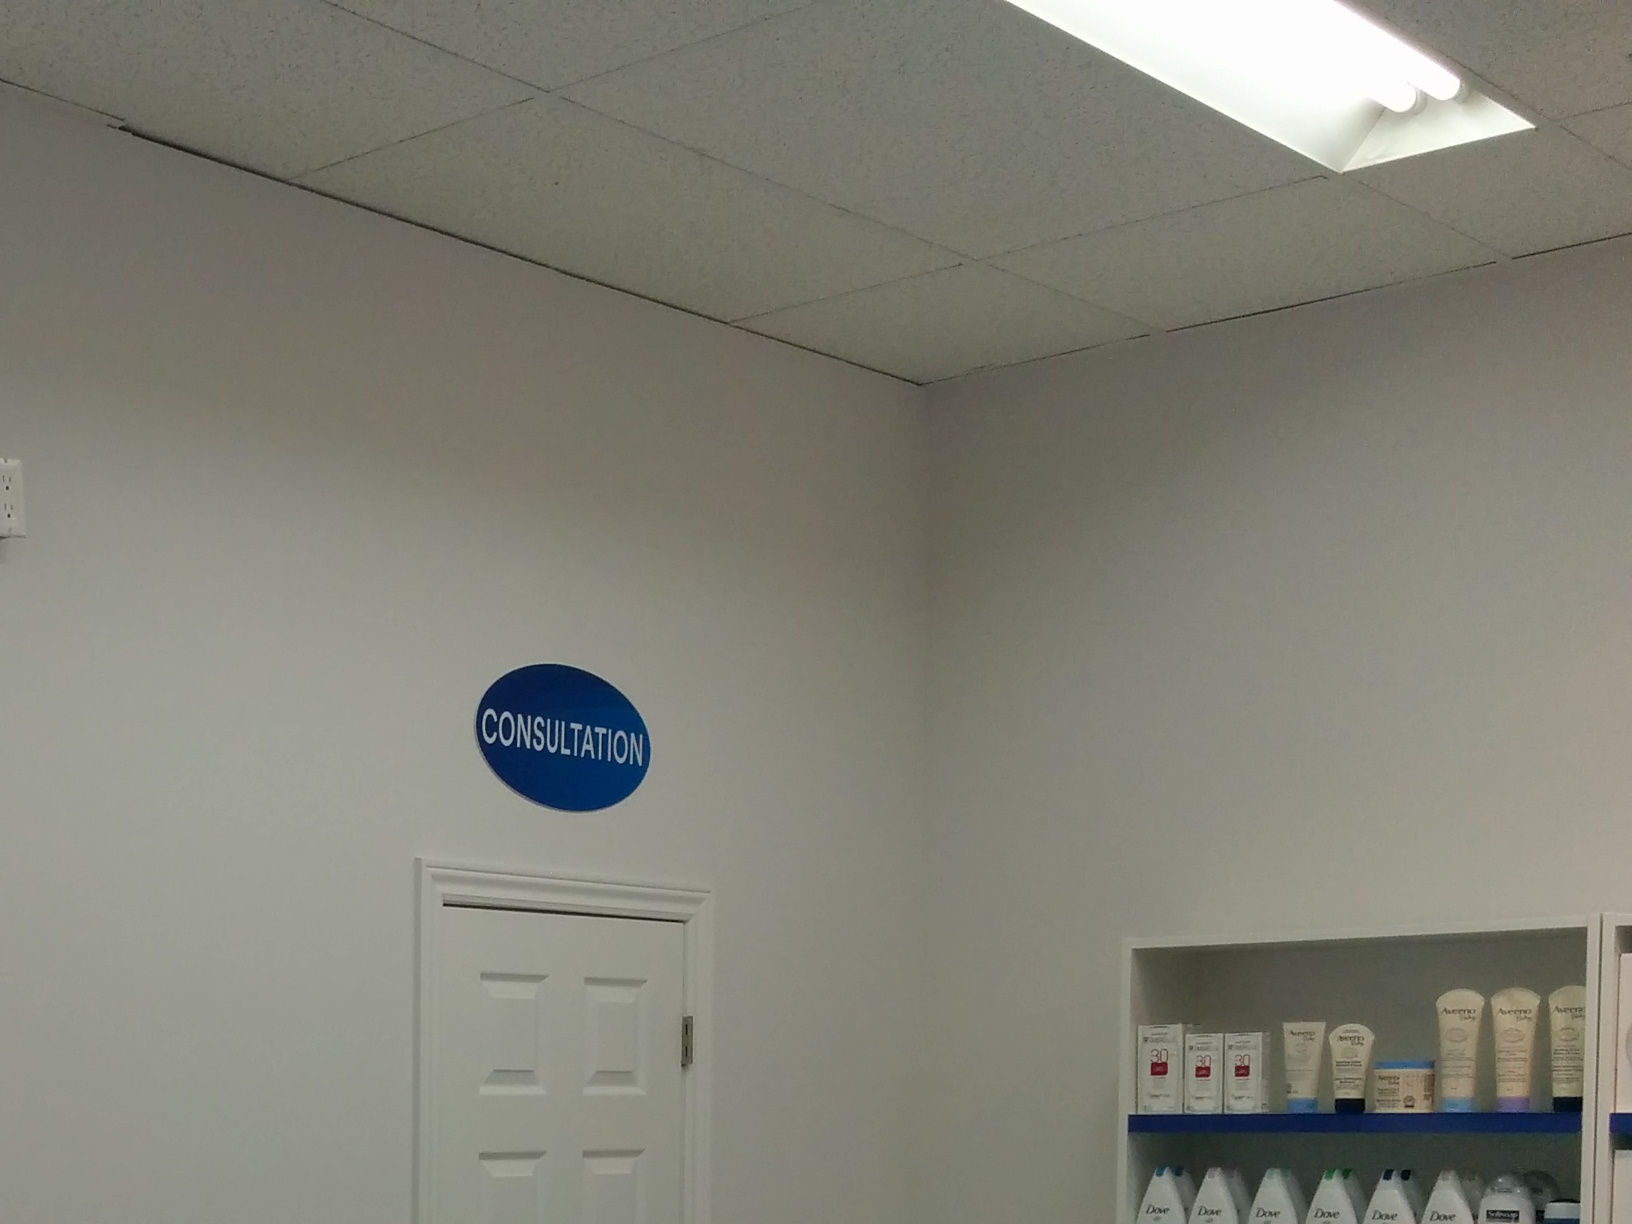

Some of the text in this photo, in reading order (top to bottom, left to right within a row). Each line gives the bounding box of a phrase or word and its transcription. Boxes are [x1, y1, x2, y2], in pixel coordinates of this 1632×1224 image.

[481, 707, 644, 767] CONSULTATION
[1150, 1048, 1169, 1063] 30
[1196, 1054, 1212, 1067] 30
[1234, 1053, 1251, 1066] 30
[1145, 1203, 1170, 1216] Dove
[1197, 1205, 1222, 1217] Dove
[1255, 1206, 1281, 1219] Dove
[1313, 1207, 1341, 1220] Dove
[1371, 1209, 1398, 1222] Dove
[1429, 1210, 1457, 1223] Dove
